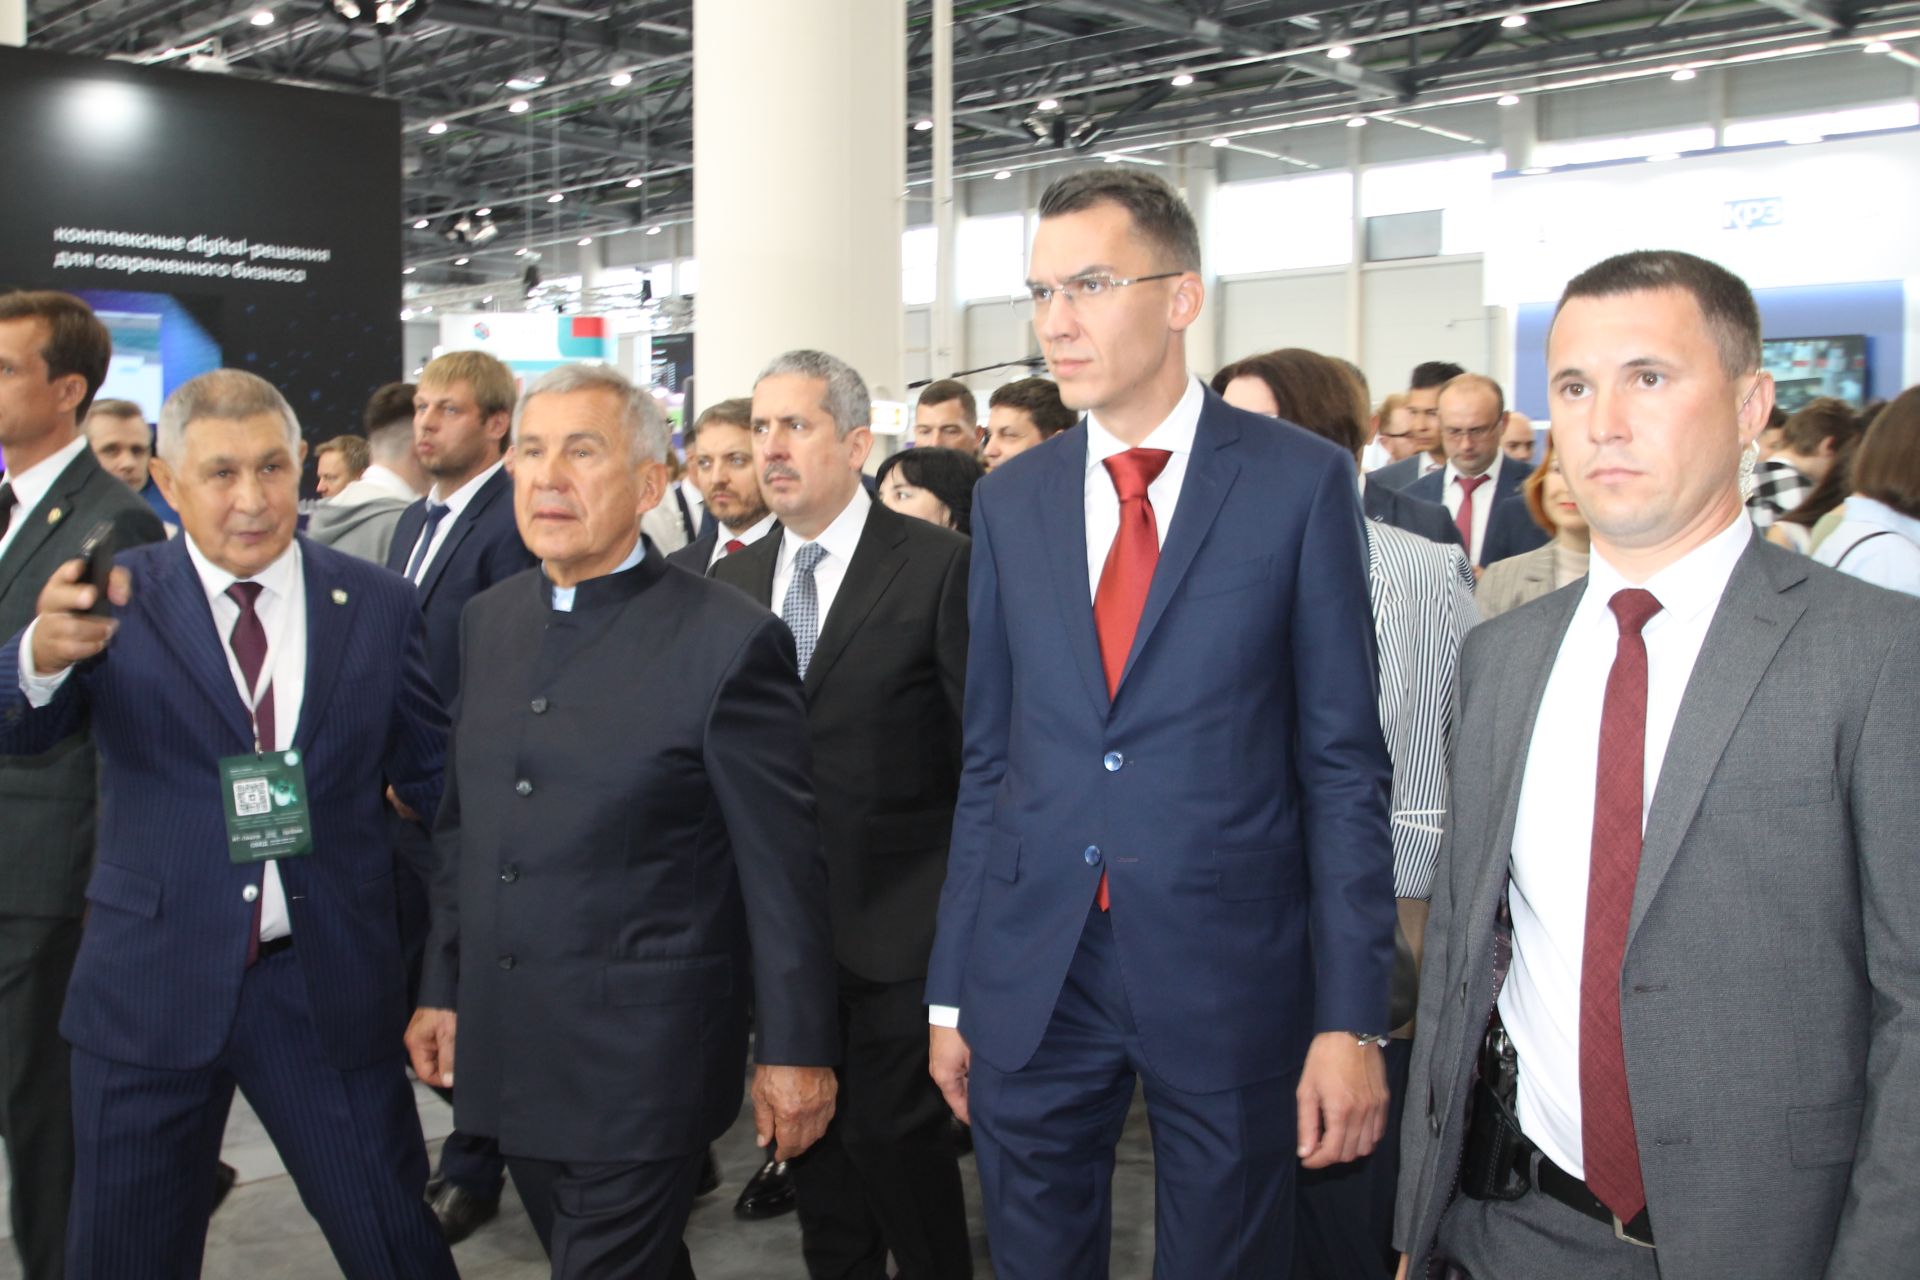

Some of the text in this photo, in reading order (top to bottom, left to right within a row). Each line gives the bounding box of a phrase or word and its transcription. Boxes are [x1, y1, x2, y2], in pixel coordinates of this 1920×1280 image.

[53, 227, 331, 262] комплексные digital-решения
[53, 251, 307, 283] для современного бизнеса
